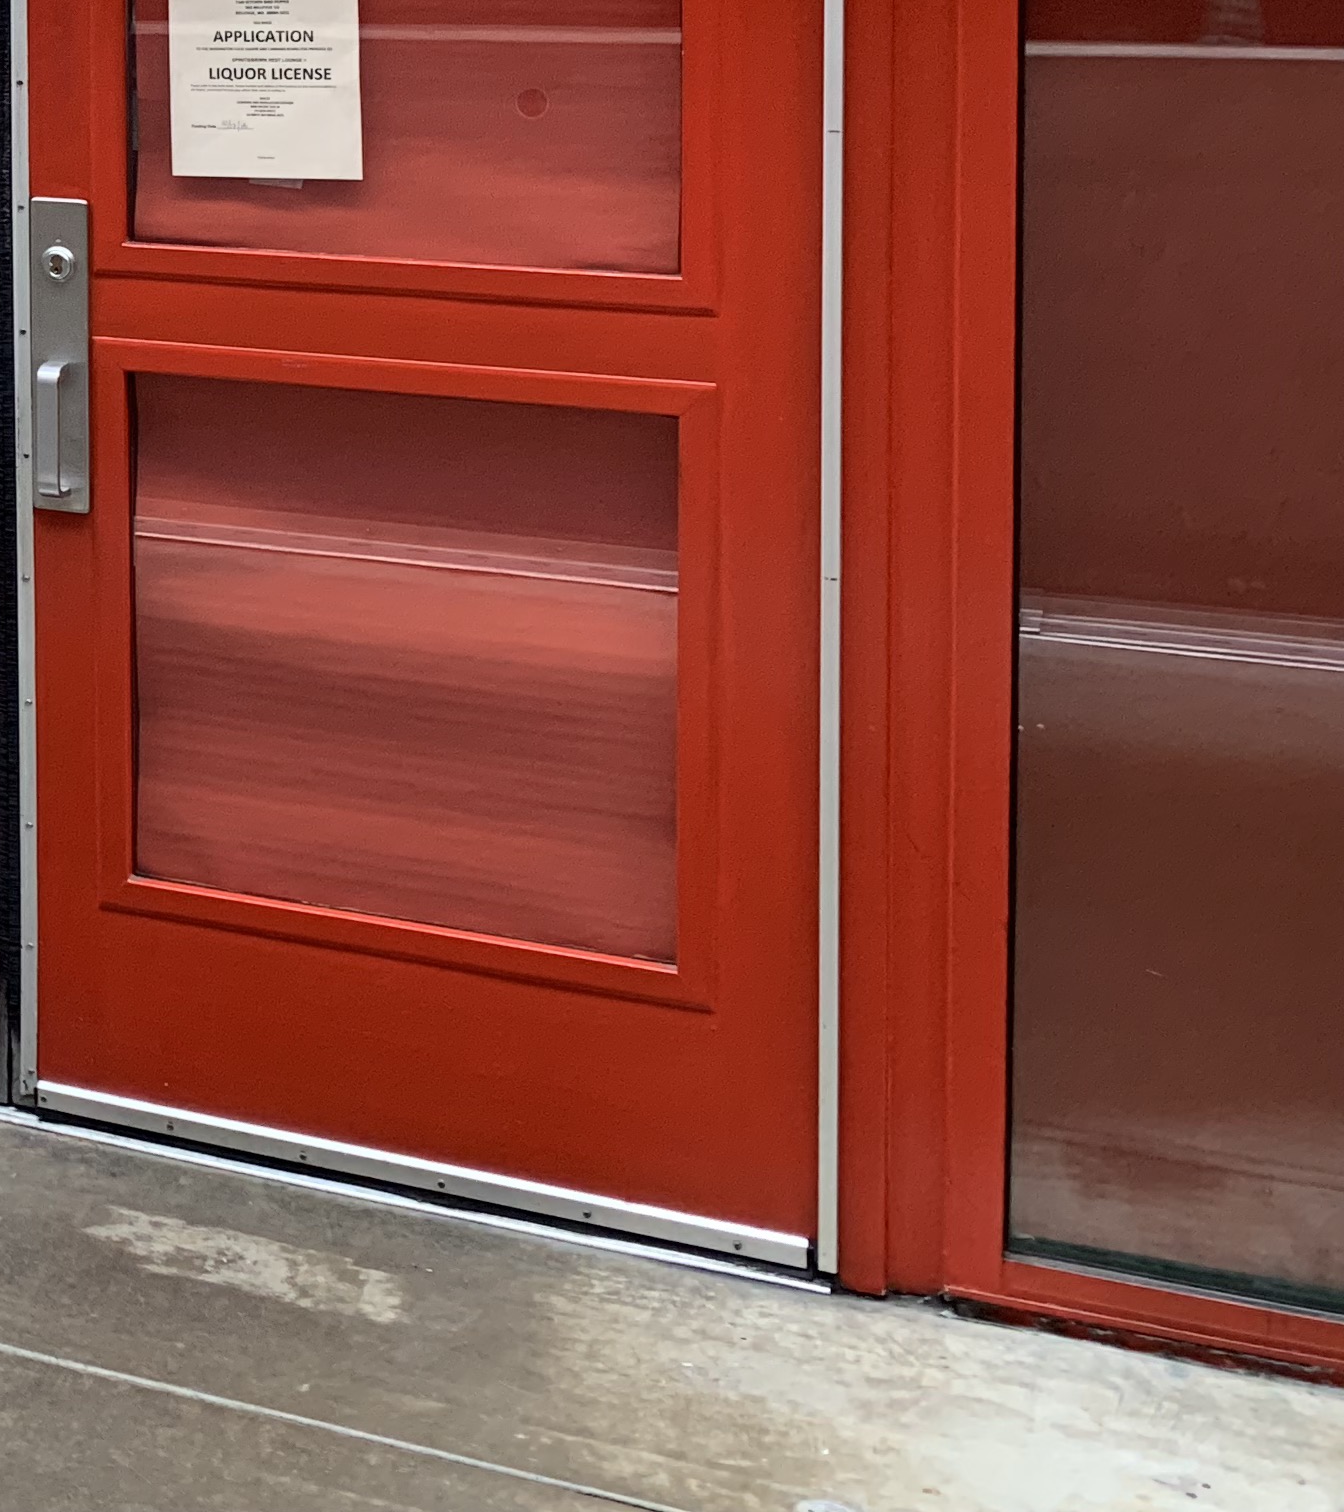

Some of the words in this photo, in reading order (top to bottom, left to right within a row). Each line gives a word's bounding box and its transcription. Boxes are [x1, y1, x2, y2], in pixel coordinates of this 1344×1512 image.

[213, 30, 314, 43] APPLICATION
[209, 67, 267, 81] LIQUOR
[271, 67, 332, 80] LICENSE
